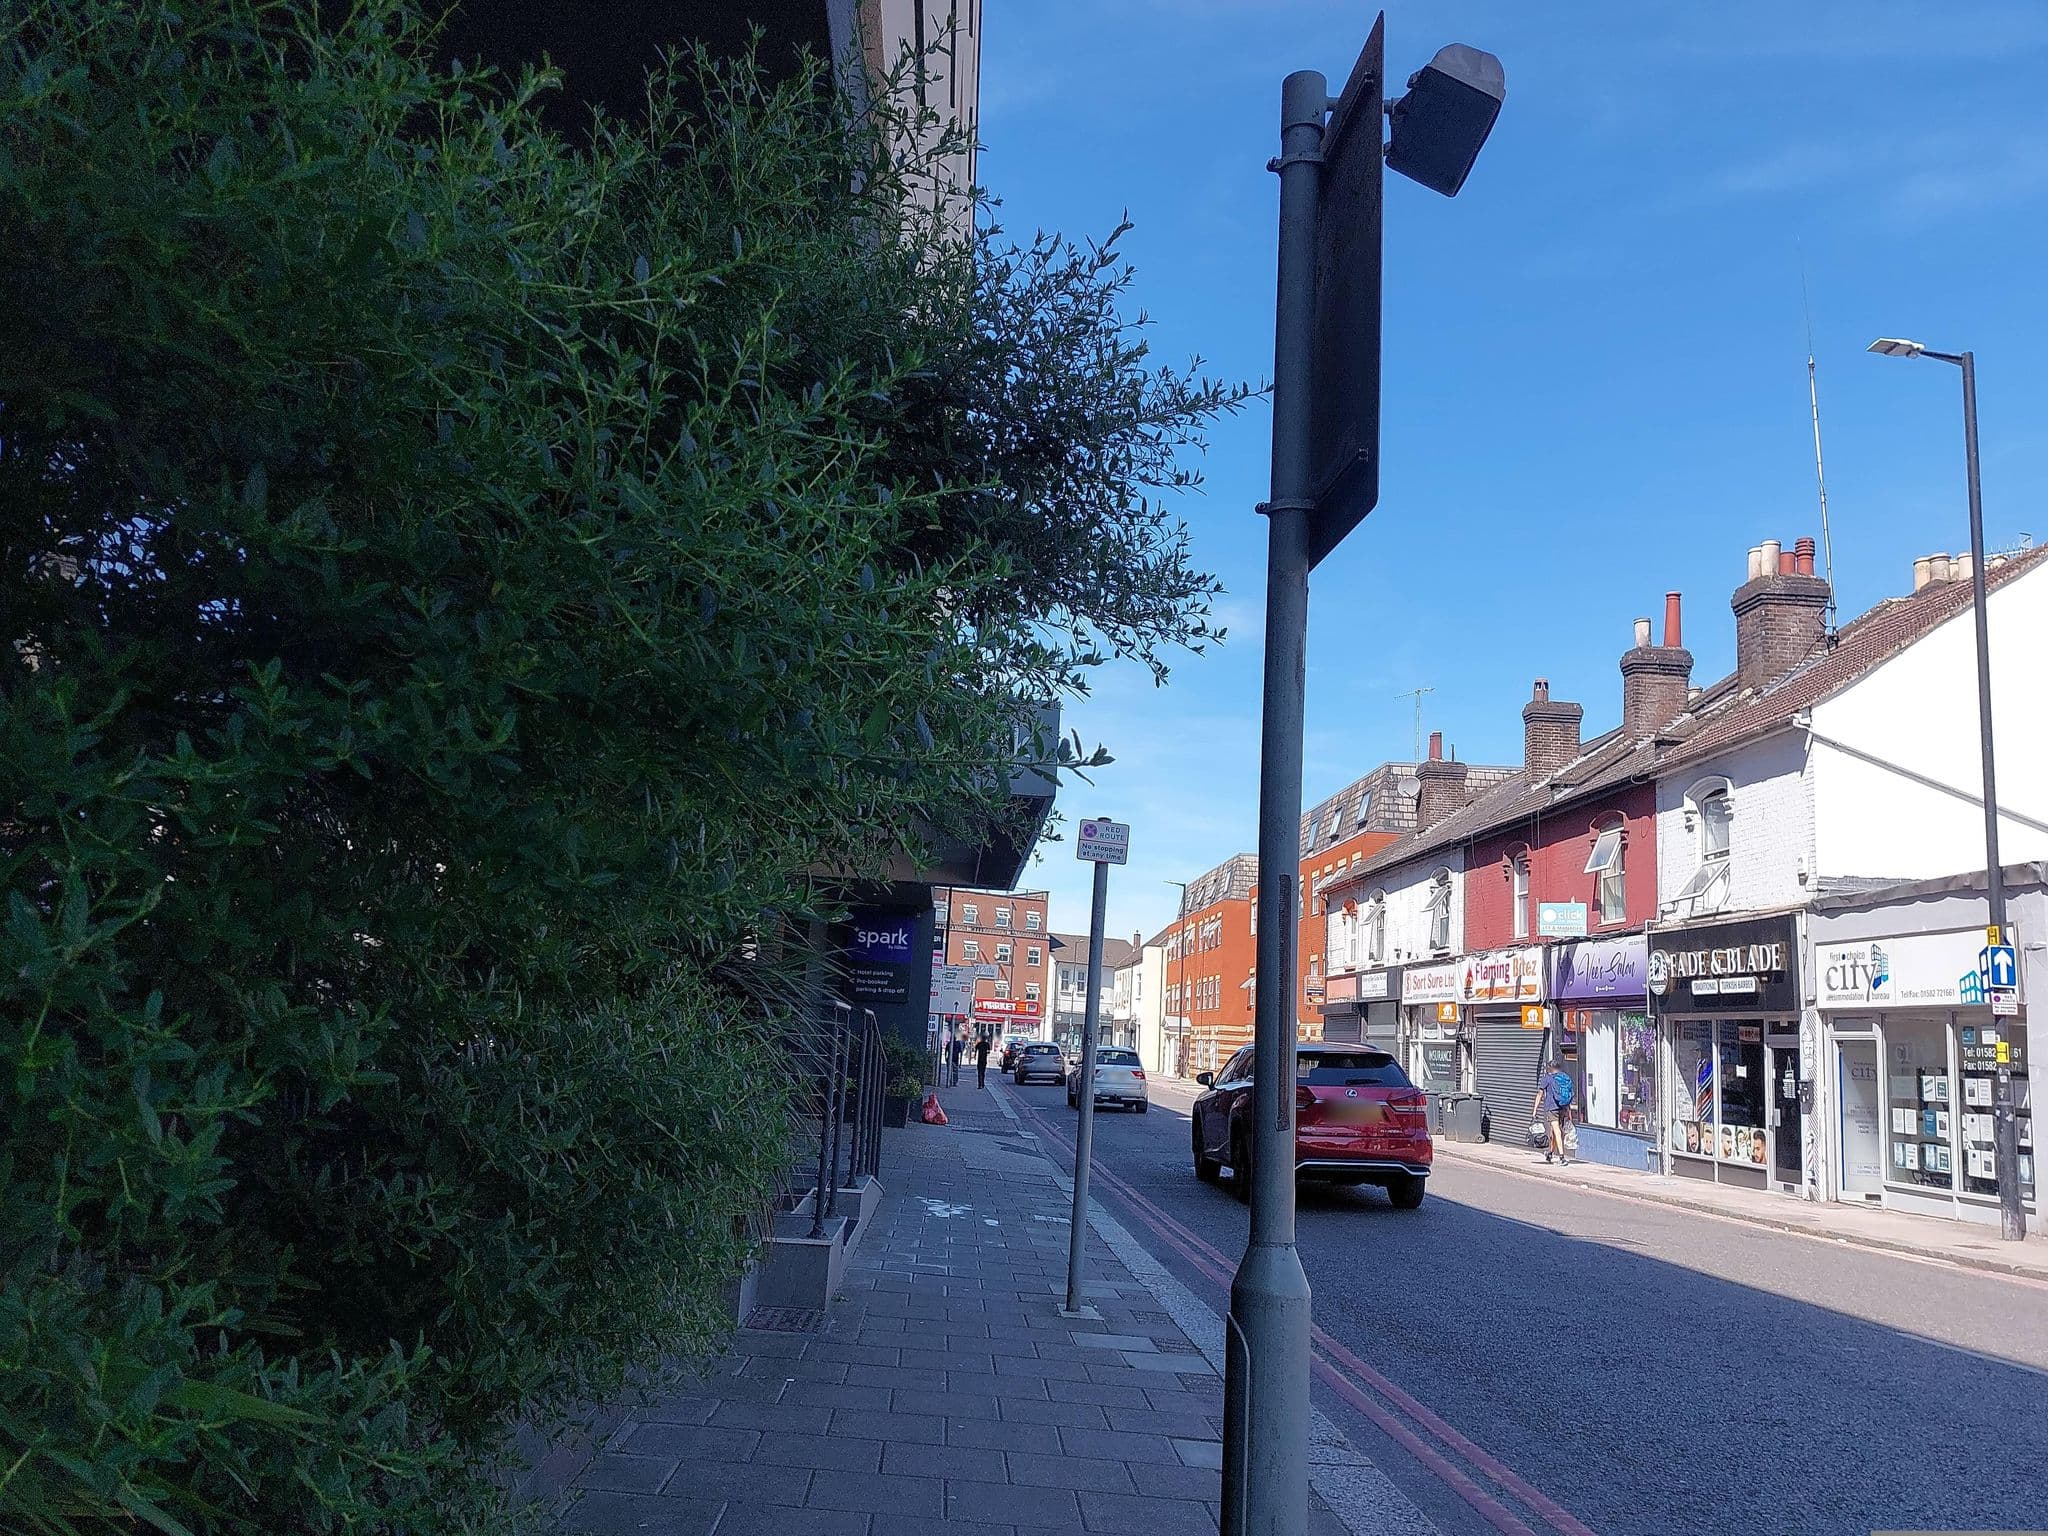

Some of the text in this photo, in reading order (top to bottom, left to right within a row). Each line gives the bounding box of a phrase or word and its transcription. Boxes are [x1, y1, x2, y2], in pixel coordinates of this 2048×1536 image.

[1105, 826, 1121, 834] RED
[1099, 832, 1124, 841] ROUTE
[1094, 844, 1124, 855] stopping
[1557, 908, 1584, 920] click
[857, 928, 909, 948] spark
[1669, 943, 1782, 978] FADE & BLADE
[1829, 950, 1866, 962] first choice
[1475, 956, 1537, 984] Flaming Bitez
[1605, 952, 1636, 983] Salon
[1412, 971, 1455, 991] Sort Sure Ltd
[1825, 958, 1877, 1002] city
[1872, 992, 1890, 1000] bureau
[982, 1001, 1016, 1011] MARKET
[1429, 1050, 1453, 1062] INSURANCE
[1963, 1047, 1976, 1059] Tel:
[1976, 1047, 1997, 1058] 01582
[1963, 1060, 1977, 1071] Fax:
[1977, 1060, 1998, 1071] 01582
